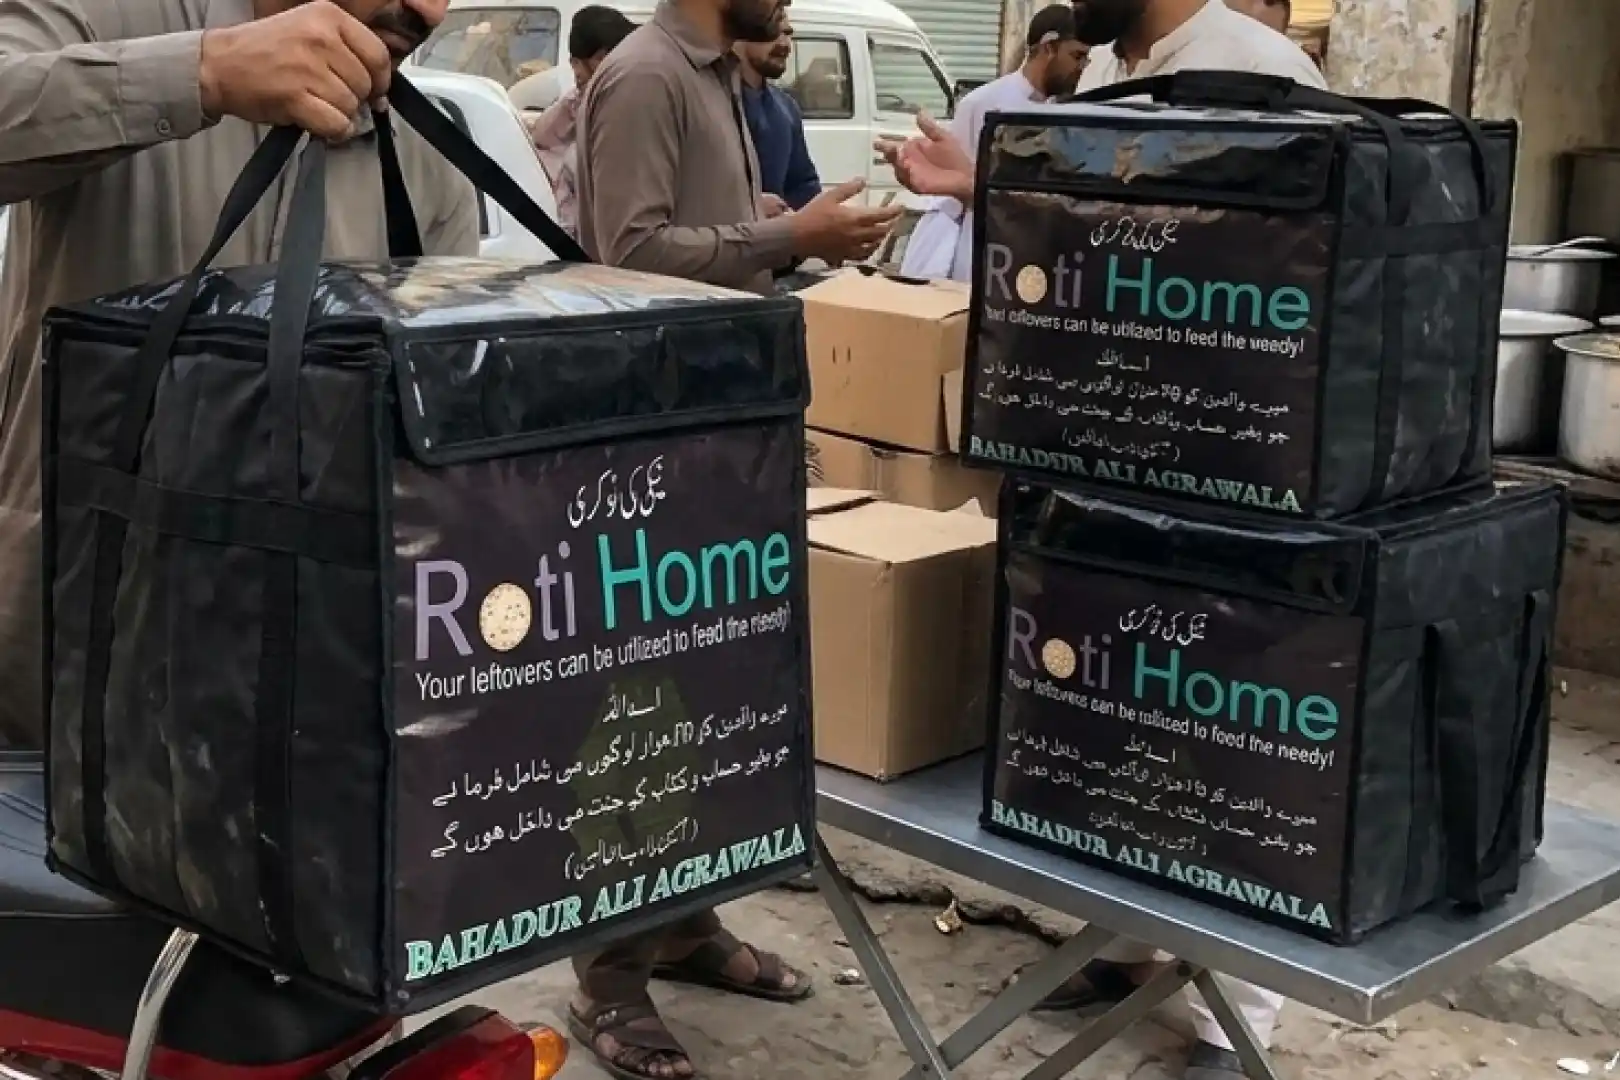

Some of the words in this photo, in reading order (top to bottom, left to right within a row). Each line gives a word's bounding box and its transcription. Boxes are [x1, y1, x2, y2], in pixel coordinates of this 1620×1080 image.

[1064, 316, 1089, 332] can
[1105, 253, 1311, 331] Home
[969, 434, 1090, 477] BAHADUR
[1093, 458, 1138, 485] ALI
[1144, 467, 1302, 513] AGRAWALA
[598, 528, 791, 631] Home
[415, 672, 466, 702] Your
[470, 661, 553, 694] leftovers
[558, 652, 589, 679] can
[593, 643, 613, 673] be
[674, 628, 689, 653] to
[691, 617, 724, 649] feed
[1133, 641, 1340, 742] Home
[1119, 701, 1137, 722] be
[1249, 732, 1274, 756] the
[1278, 743, 1336, 773] needy!
[405, 893, 583, 982] BAHADUR
[588, 874, 648, 924] ALI
[648, 822, 807, 905] AGRAWALA
[991, 799, 1110, 860] BAHADUR
[1115, 845, 1162, 875] ALI
[1165, 859, 1333, 929] AGRAWALA
